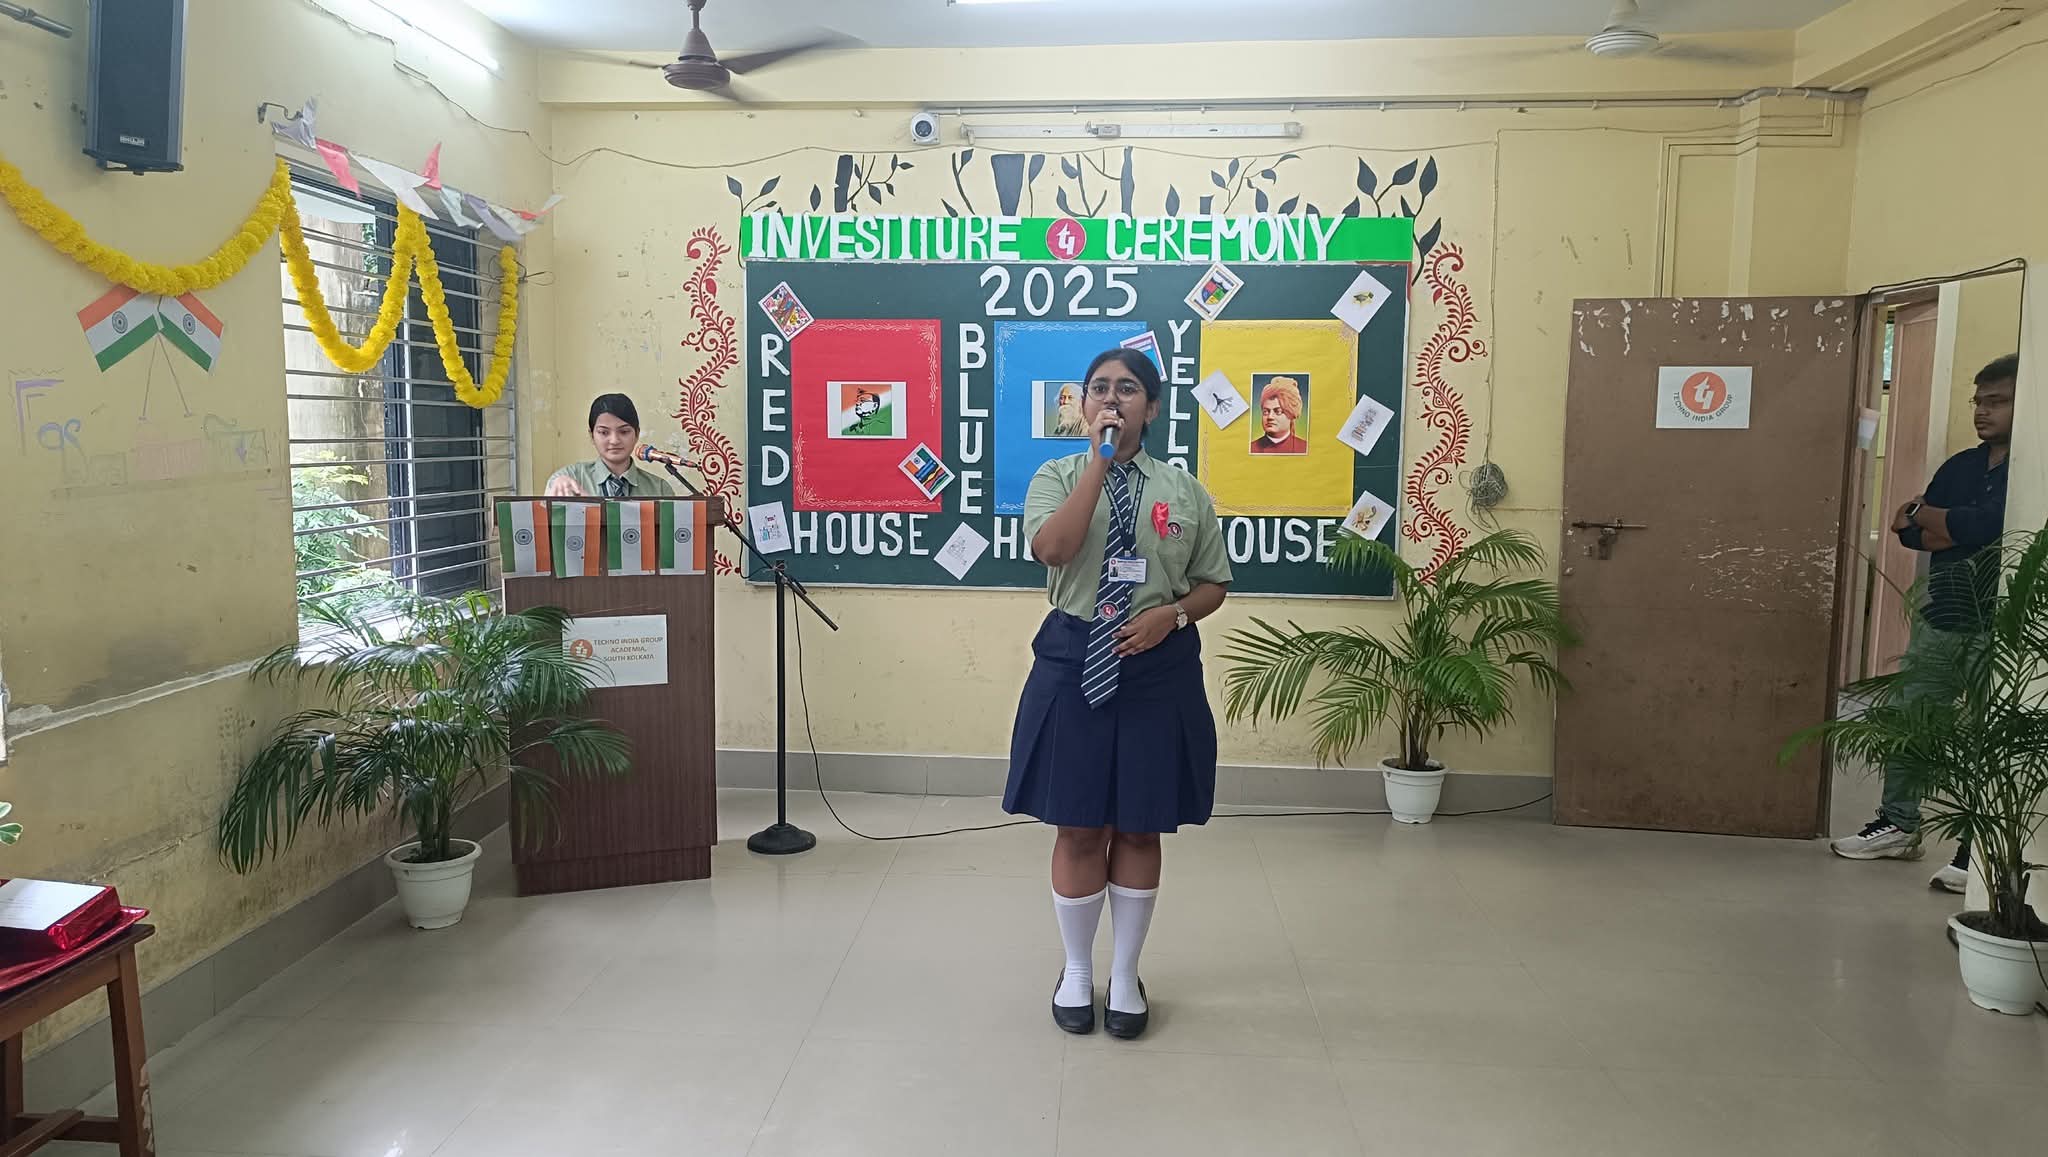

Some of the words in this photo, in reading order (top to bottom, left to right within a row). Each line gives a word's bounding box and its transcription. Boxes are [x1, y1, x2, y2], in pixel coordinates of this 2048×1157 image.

[749, 212, 1021, 261] INVESTITURE
[1106, 212, 1345, 261] CEREMONY
[980, 265, 1138, 317] 2025
[761, 333, 790, 486] RED
[959, 323, 989, 514] BLUE
[1673, 391, 1691, 418] TECHNO
[1692, 414, 1714, 423] INDIA
[1715, 393, 1733, 417] GROUP
[792, 511, 929, 556] HOUSE
[1217, 516, 1337, 564] OUSE
[593, 638, 620, 646] TECHNO
[620, 637, 640, 645] INDIA
[640, 636, 664, 644] GROUP
[626, 653, 655, 661] KOLKATA
